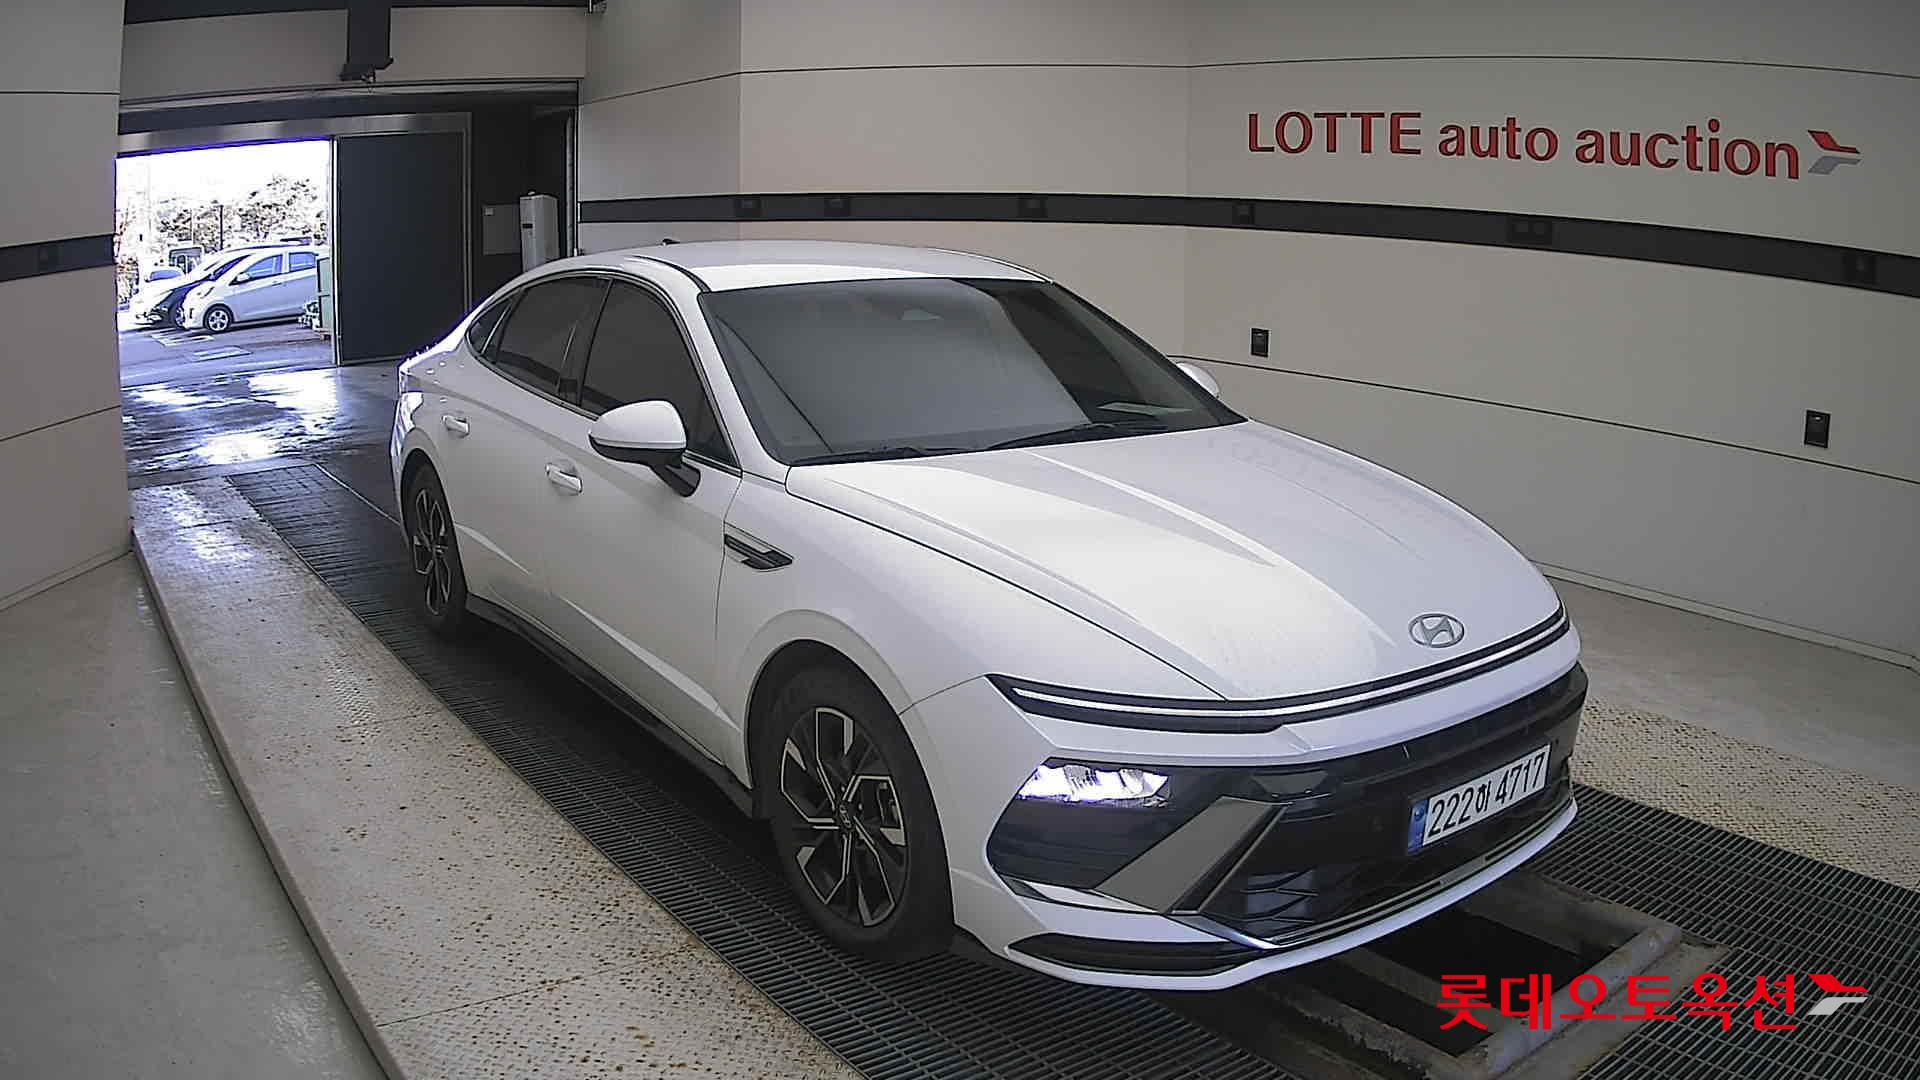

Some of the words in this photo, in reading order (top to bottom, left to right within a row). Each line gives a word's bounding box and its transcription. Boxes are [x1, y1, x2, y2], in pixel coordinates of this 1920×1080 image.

[1247, 110, 1423, 155] LOTTE
[1438, 116, 1560, 162] auto
[1575, 118, 1800, 179] auction
[1427, 780, 1491, 838] 222하
[1495, 751, 1546, 805] 4717
